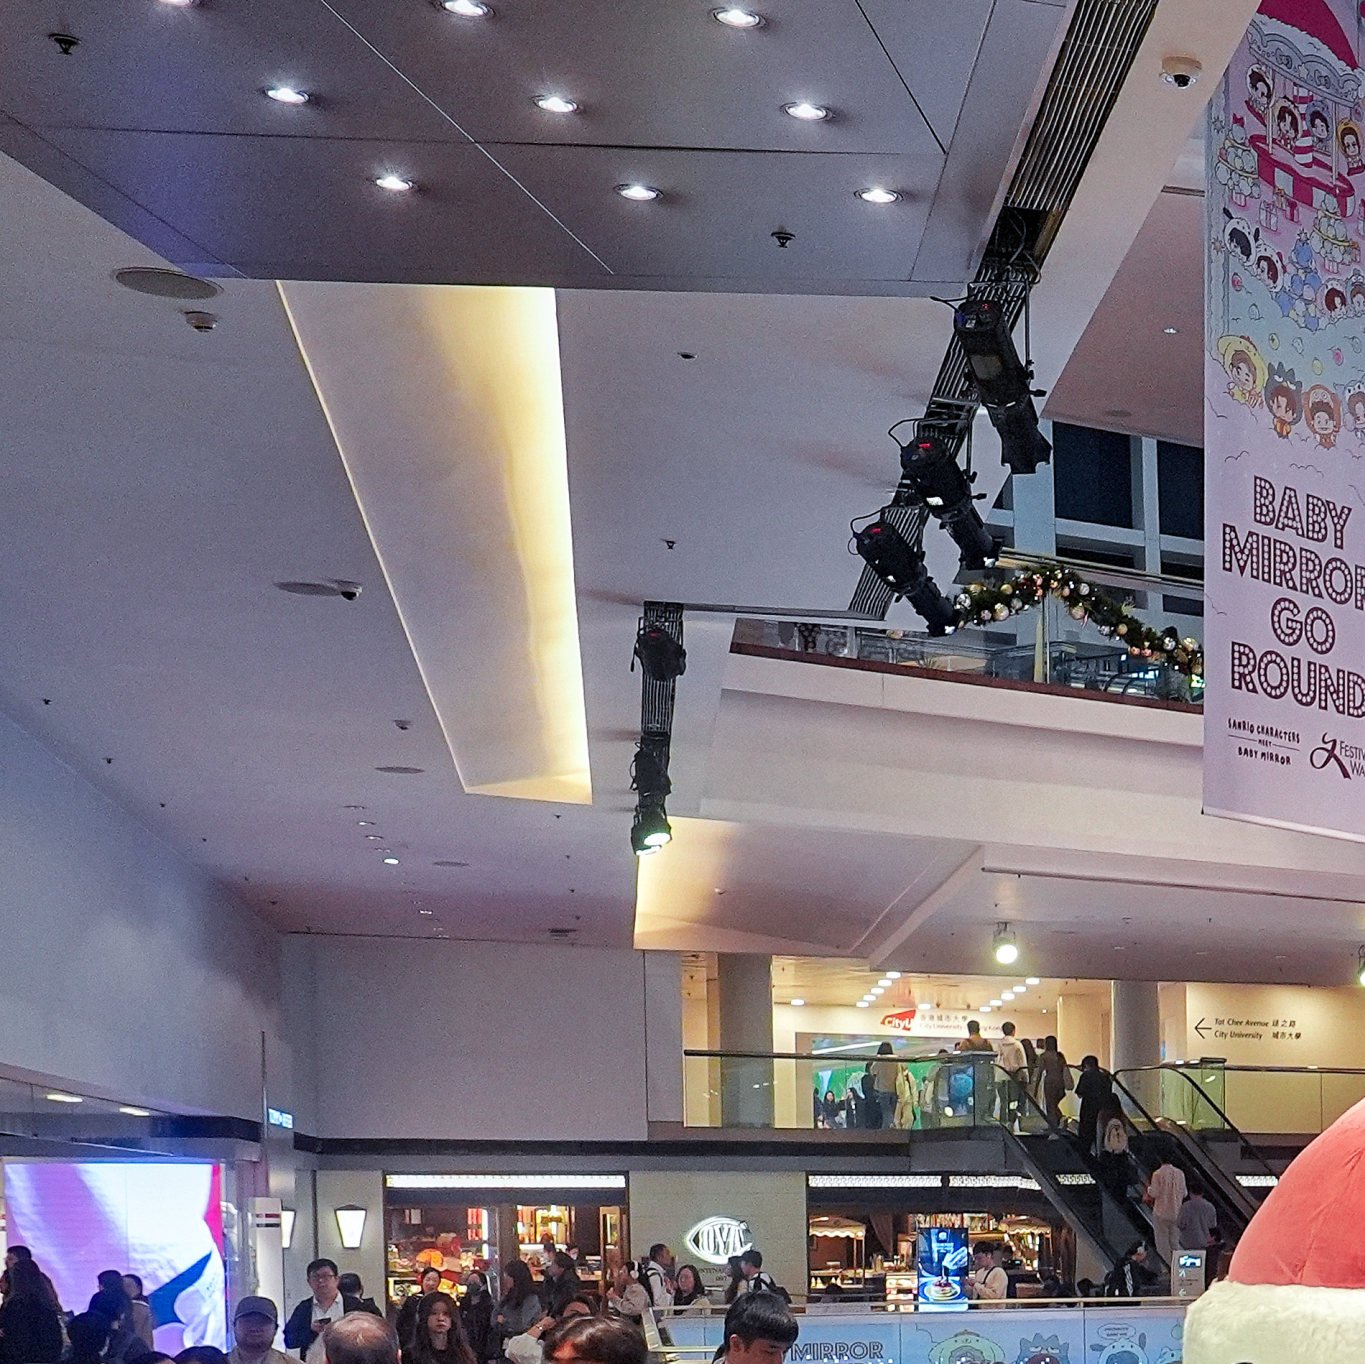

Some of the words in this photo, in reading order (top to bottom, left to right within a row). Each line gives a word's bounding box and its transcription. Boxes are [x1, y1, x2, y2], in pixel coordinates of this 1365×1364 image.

[1253, 474, 1352, 550] BABY
[1270, 597, 1336, 655] GO
[1228, 718, 1254, 734] SANRIO
[1256, 724, 1300, 744] CHARACTERS
[1238, 746, 1257, 759] BABY
[1260, 751, 1291, 765] MIRROR
[1227, 1018, 1243, 1026] Chee
[1245, 1019, 1269, 1027] Avenue
[1214, 1030, 1228, 1039] City
[1229, 1031, 1263, 1040] University
[790, 1341, 884, 1361] MIRROR
